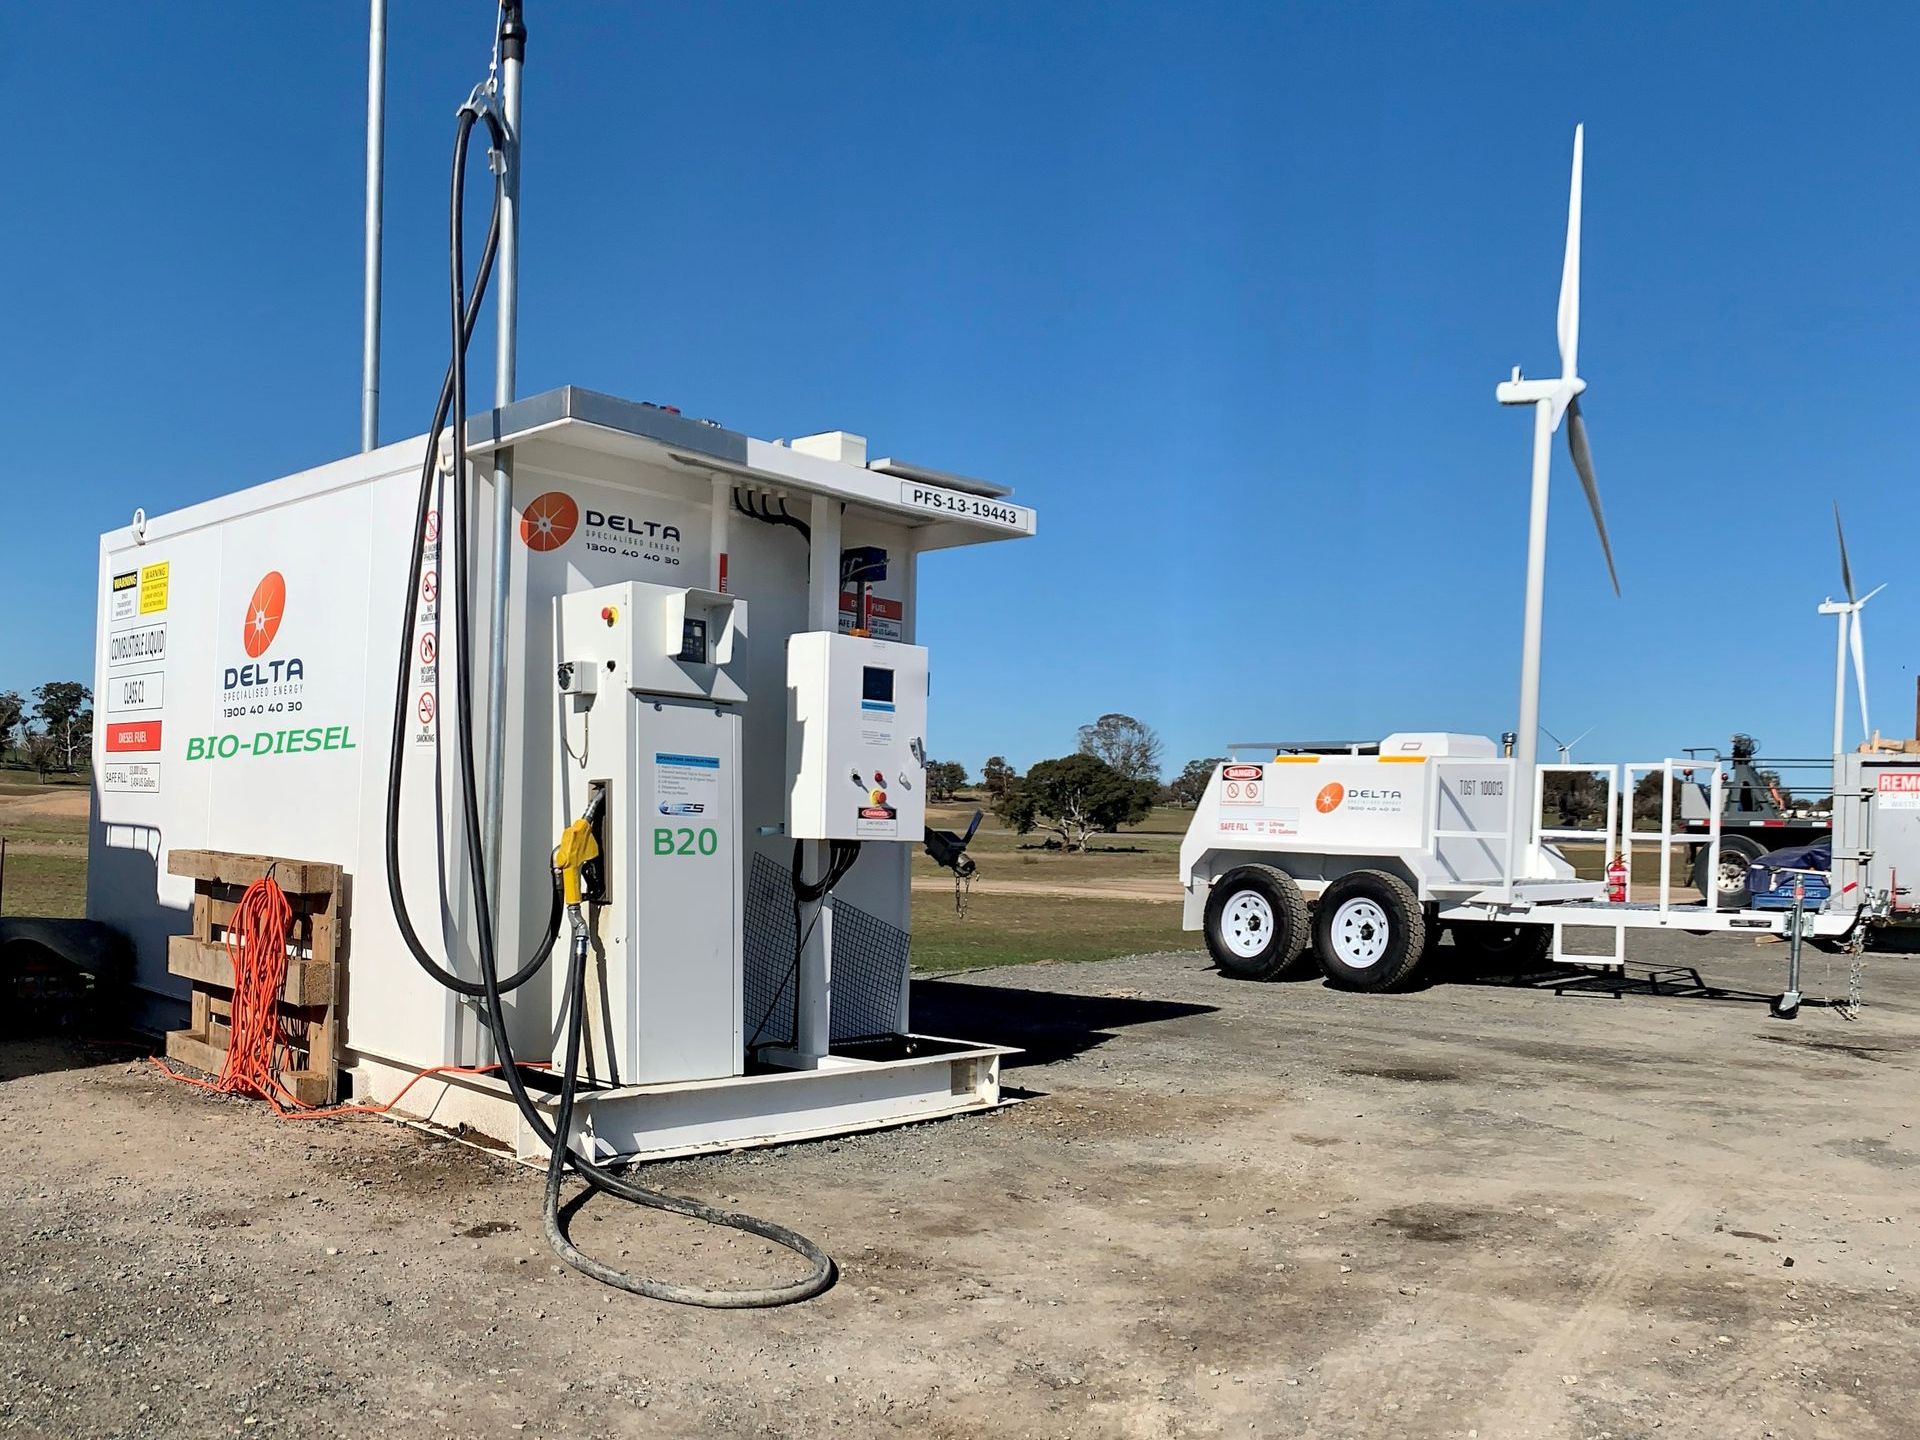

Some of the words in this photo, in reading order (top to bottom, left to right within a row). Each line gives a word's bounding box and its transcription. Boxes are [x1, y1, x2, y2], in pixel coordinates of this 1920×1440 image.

[913, 489, 1017, 524] PFS-13-19443
[586, 510, 681, 543] DELTA
[585, 542, 617, 554] 1300
[621, 548, 639, 558] 40
[643, 552, 660, 562] 40
[664, 556, 680, 566] 30
[586, 529, 645, 548] SPECIALISED
[649, 540, 681, 554] ENERGY
[145, 629, 165, 658] LIQUID
[223, 658, 304, 690] DELTA
[223, 686, 269, 702] SPECIALISED
[273, 684, 304, 696] ENERGY
[223, 706, 246, 718] 1300
[249, 704, 264, 715] 40
[268, 702, 284, 713] 40
[287, 701, 303, 712] 30
[134, 731, 147, 743] FUEL
[186, 725, 357, 761] BIO-DIESEL
[1348, 789, 1402, 799] DELTA
[1220, 822, 1235, 831] SAFE
[1235, 822, 1249, 831] FILL
[653, 827, 718, 856] B20
